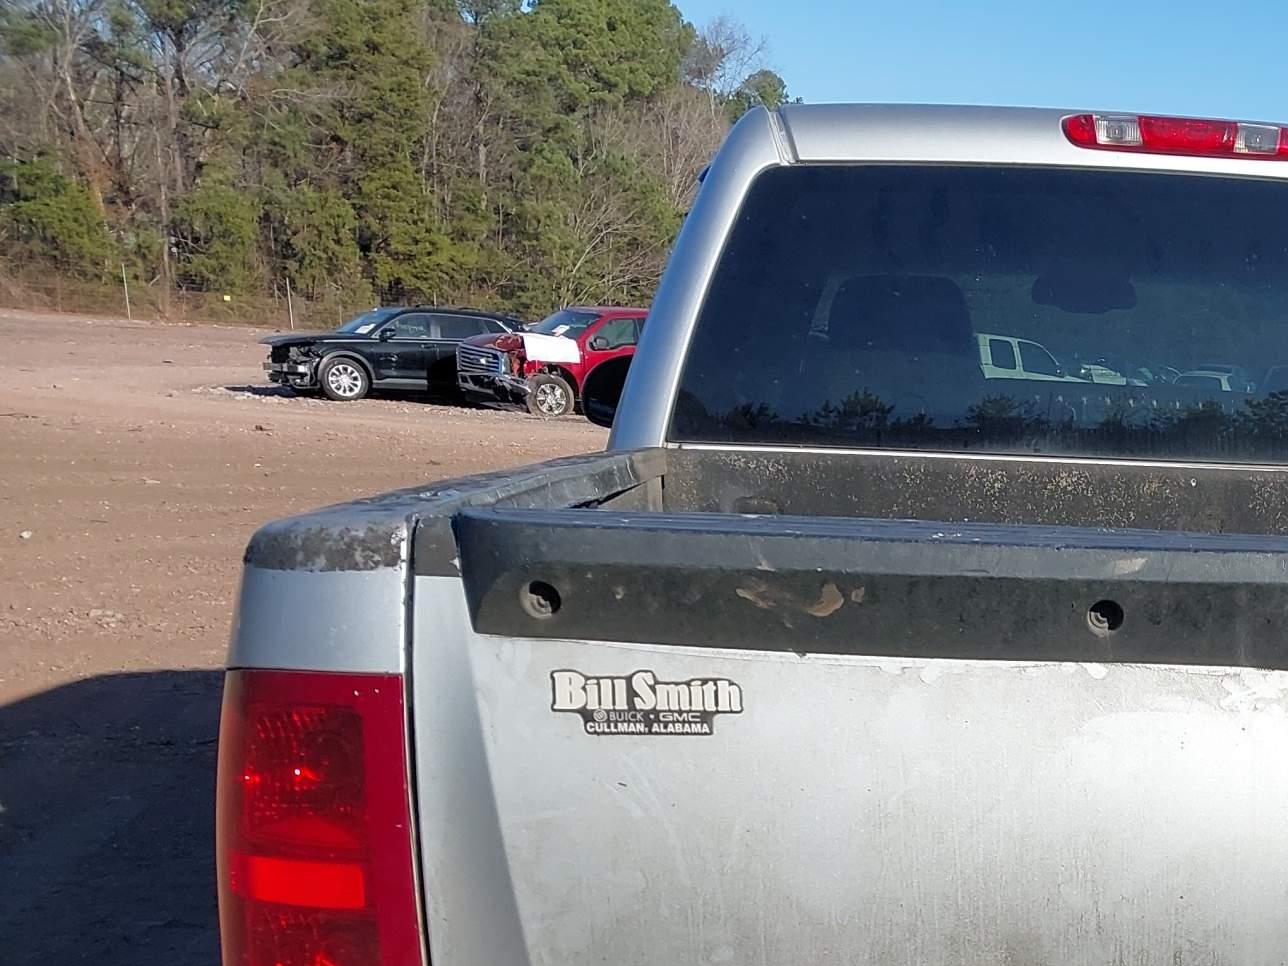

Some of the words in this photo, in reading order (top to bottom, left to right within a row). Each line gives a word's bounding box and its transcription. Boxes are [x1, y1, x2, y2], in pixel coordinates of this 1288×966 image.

[552, 671, 629, 711] Bill
[631, 671, 743, 712] Smith
[609, 712, 644, 722] BUICK
[659, 713, 701, 722] GMC
[586, 722, 649, 734] CULLMAN,
[651, 722, 711, 734] ALABAMA
